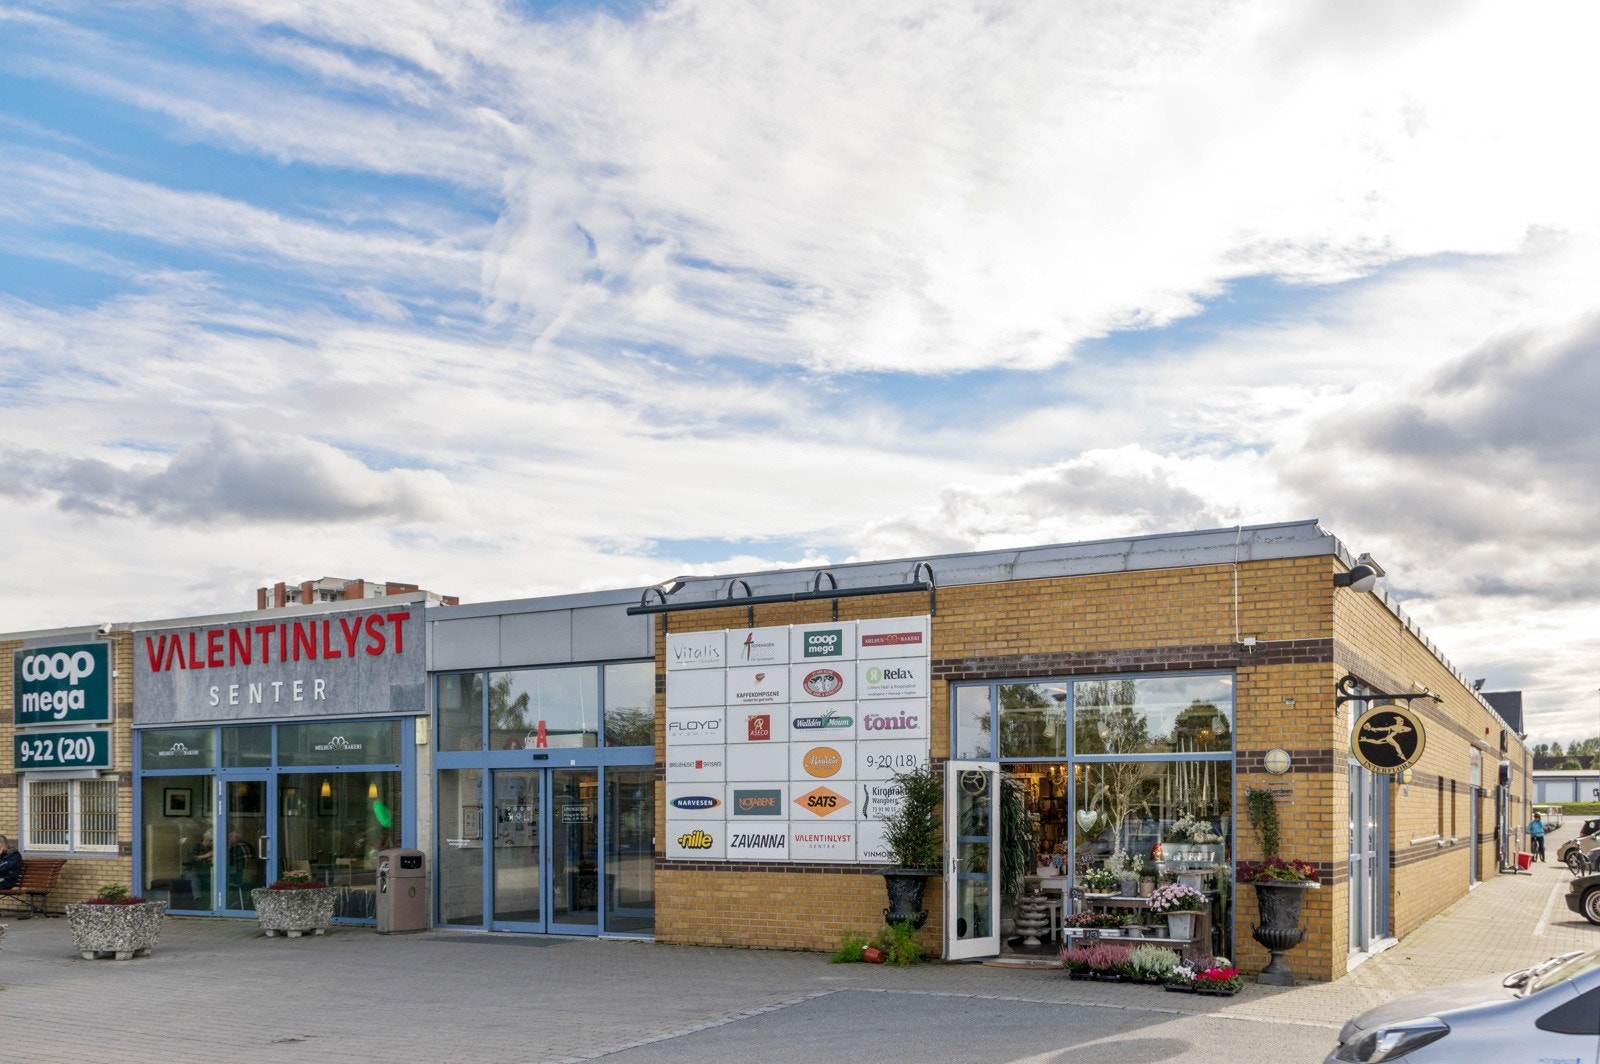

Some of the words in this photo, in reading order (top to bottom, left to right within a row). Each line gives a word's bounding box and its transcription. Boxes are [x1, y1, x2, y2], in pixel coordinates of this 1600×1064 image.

[145, 612, 410, 673] VALENTINLYST
[808, 634, 838, 645] coop
[673, 643, 720, 660] Vitalis
[808, 645, 834, 655] mega
[22, 651, 95, 685] coop
[883, 668, 914, 680] Relax
[209, 678, 326, 707] SENTER
[22, 689, 85, 720] mega
[669, 720, 719, 731] FLOYD
[864, 710, 918, 731] tonic
[21, 739, 54, 762] 9-22
[57, 736, 95, 763] (20)
[866, 755, 892, 768] 9-20
[895, 754, 917, 768] (18)
[1363, 760, 1414, 774] INTERFLORA
[807, 795, 837, 807] SATS
[730, 834, 786, 849] ZAVANNA
[794, 834, 851, 843] VALENTINLYST
